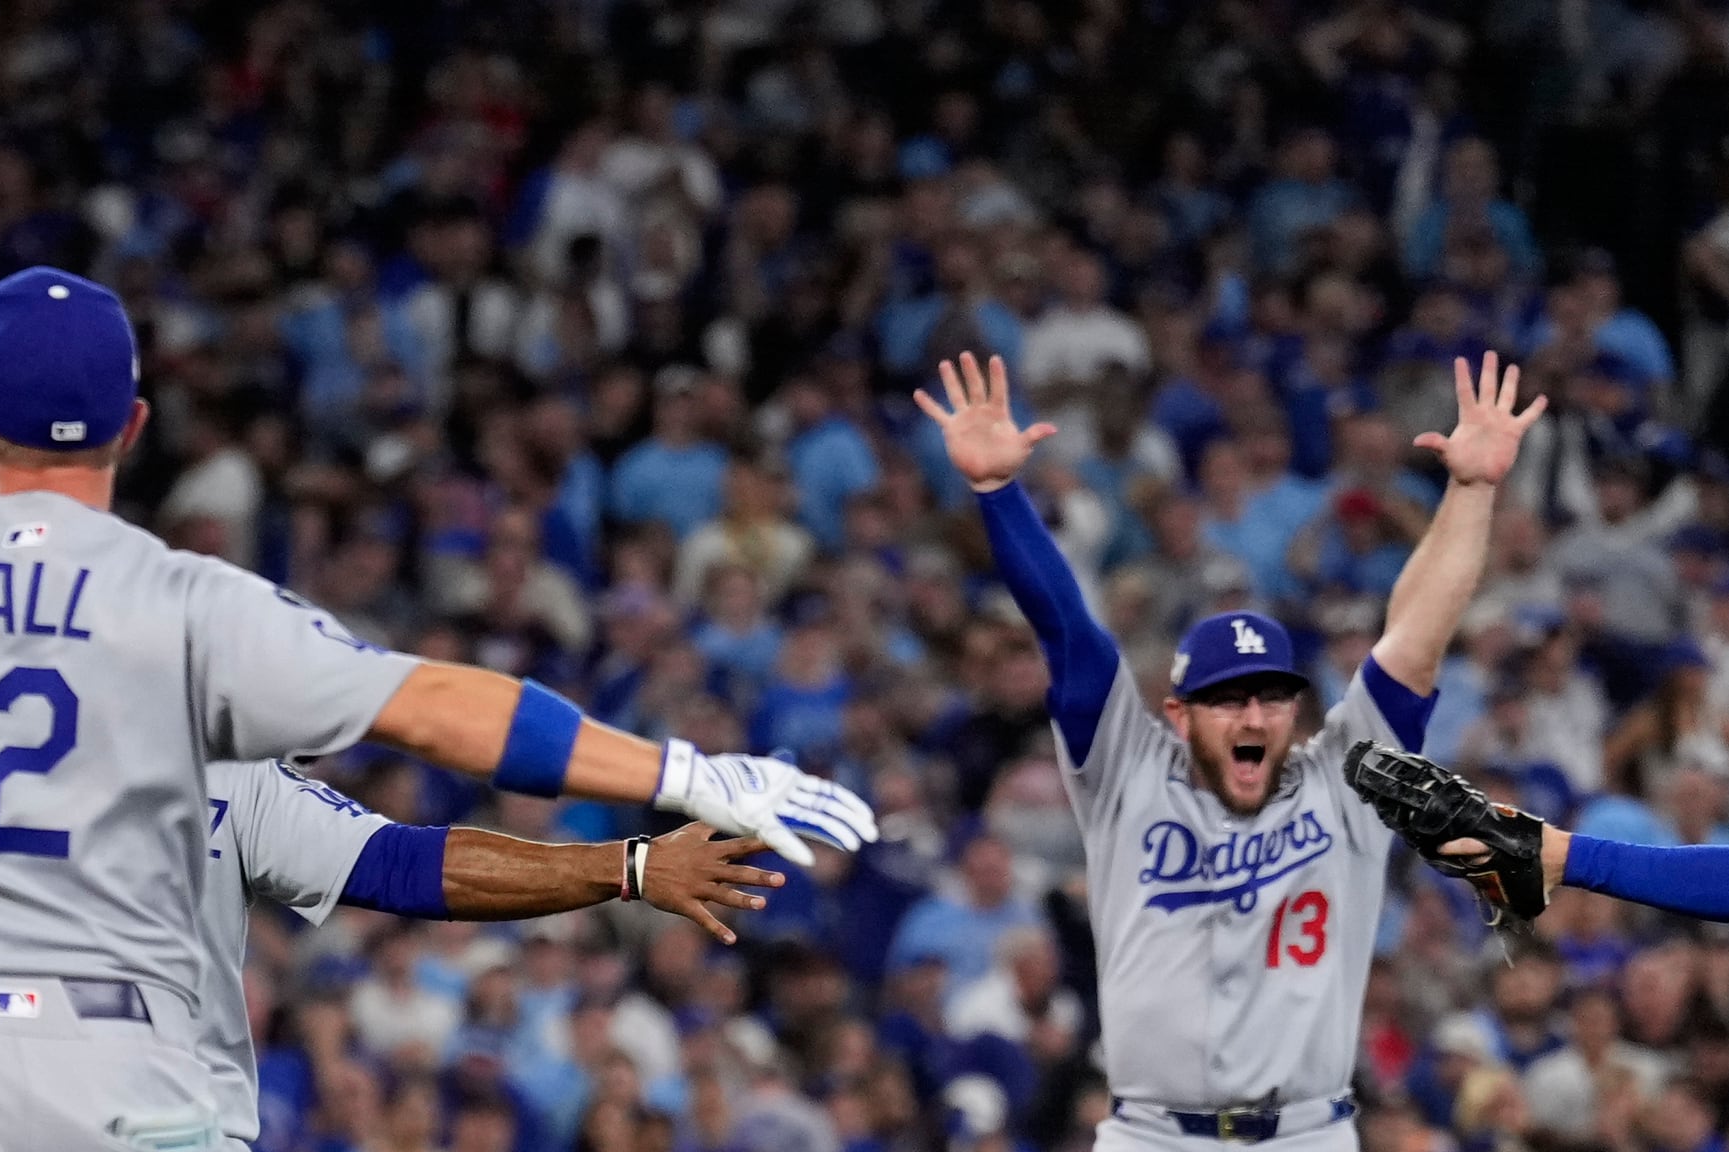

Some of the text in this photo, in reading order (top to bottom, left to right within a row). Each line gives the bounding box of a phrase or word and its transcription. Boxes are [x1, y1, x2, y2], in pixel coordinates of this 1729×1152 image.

[1231, 619, 1267, 654] LA
[1139, 811, 1332, 914] Dodgers
[1266, 891, 1328, 969] 13
